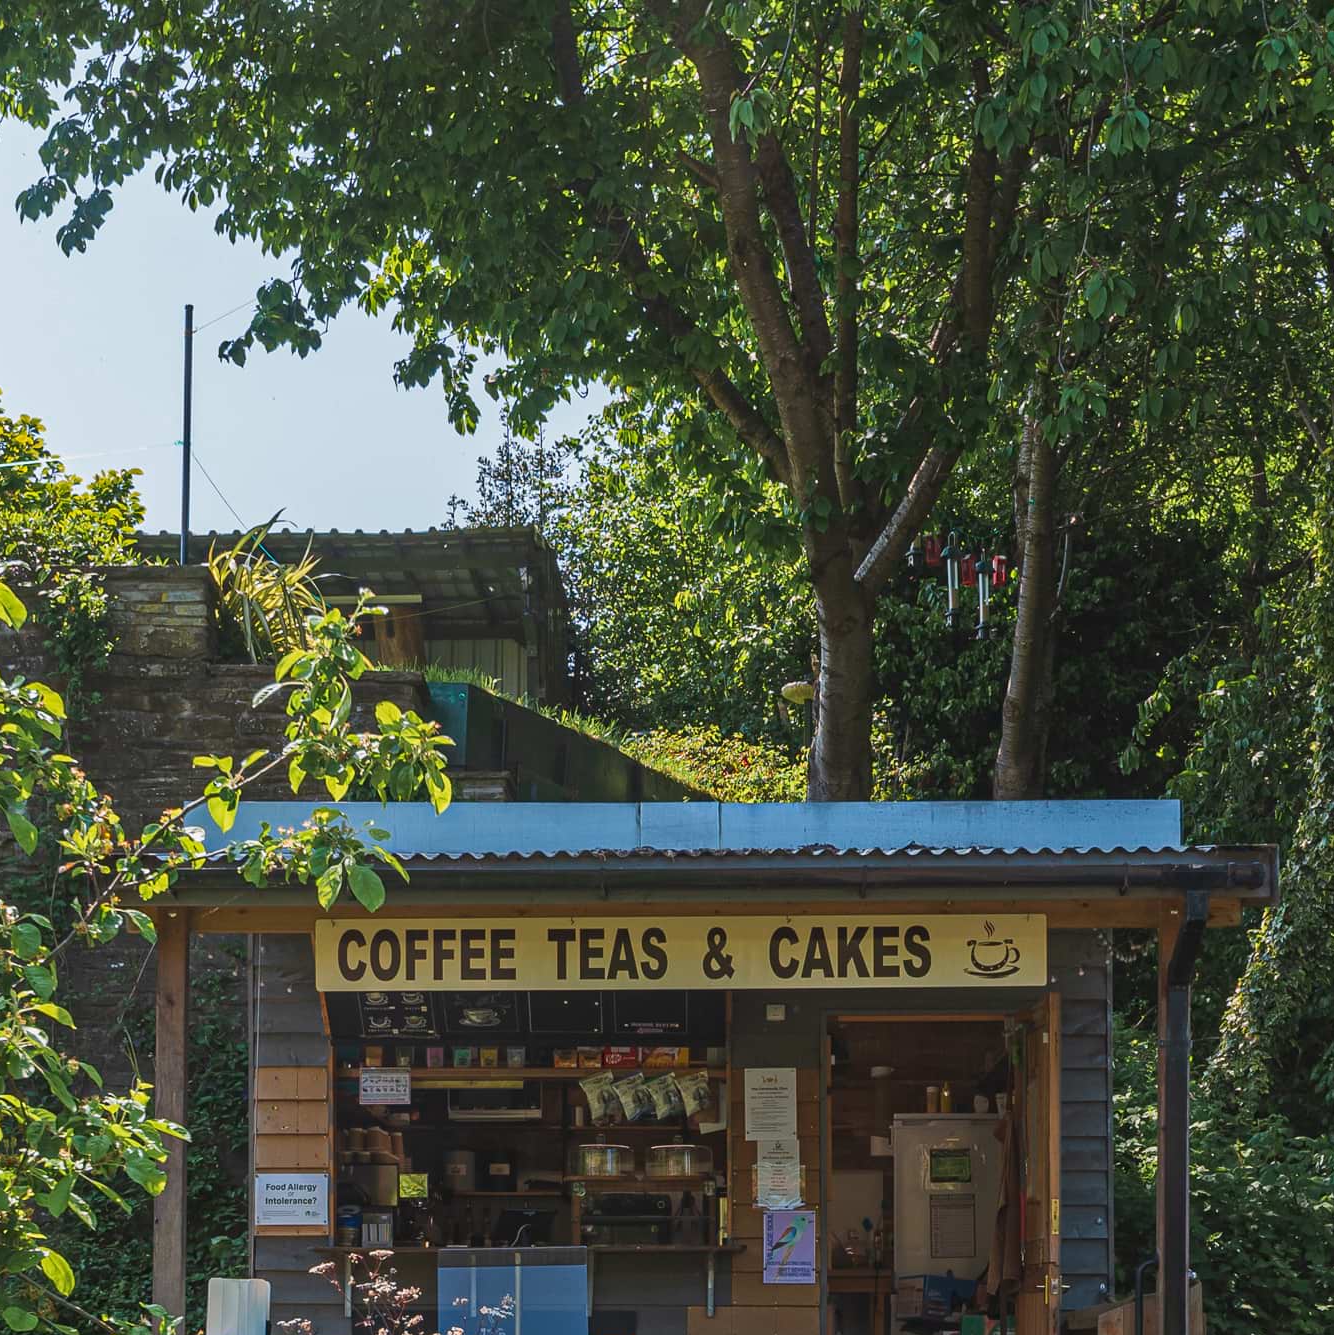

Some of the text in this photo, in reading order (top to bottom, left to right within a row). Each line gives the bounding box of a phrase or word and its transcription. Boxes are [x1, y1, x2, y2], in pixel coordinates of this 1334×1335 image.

[337, 925, 933, 982] COFFEE TEAS & CAKES
[265, 1183, 317, 1192] Food Allergy
[265, 1197, 318, 1205] Intolerance?
